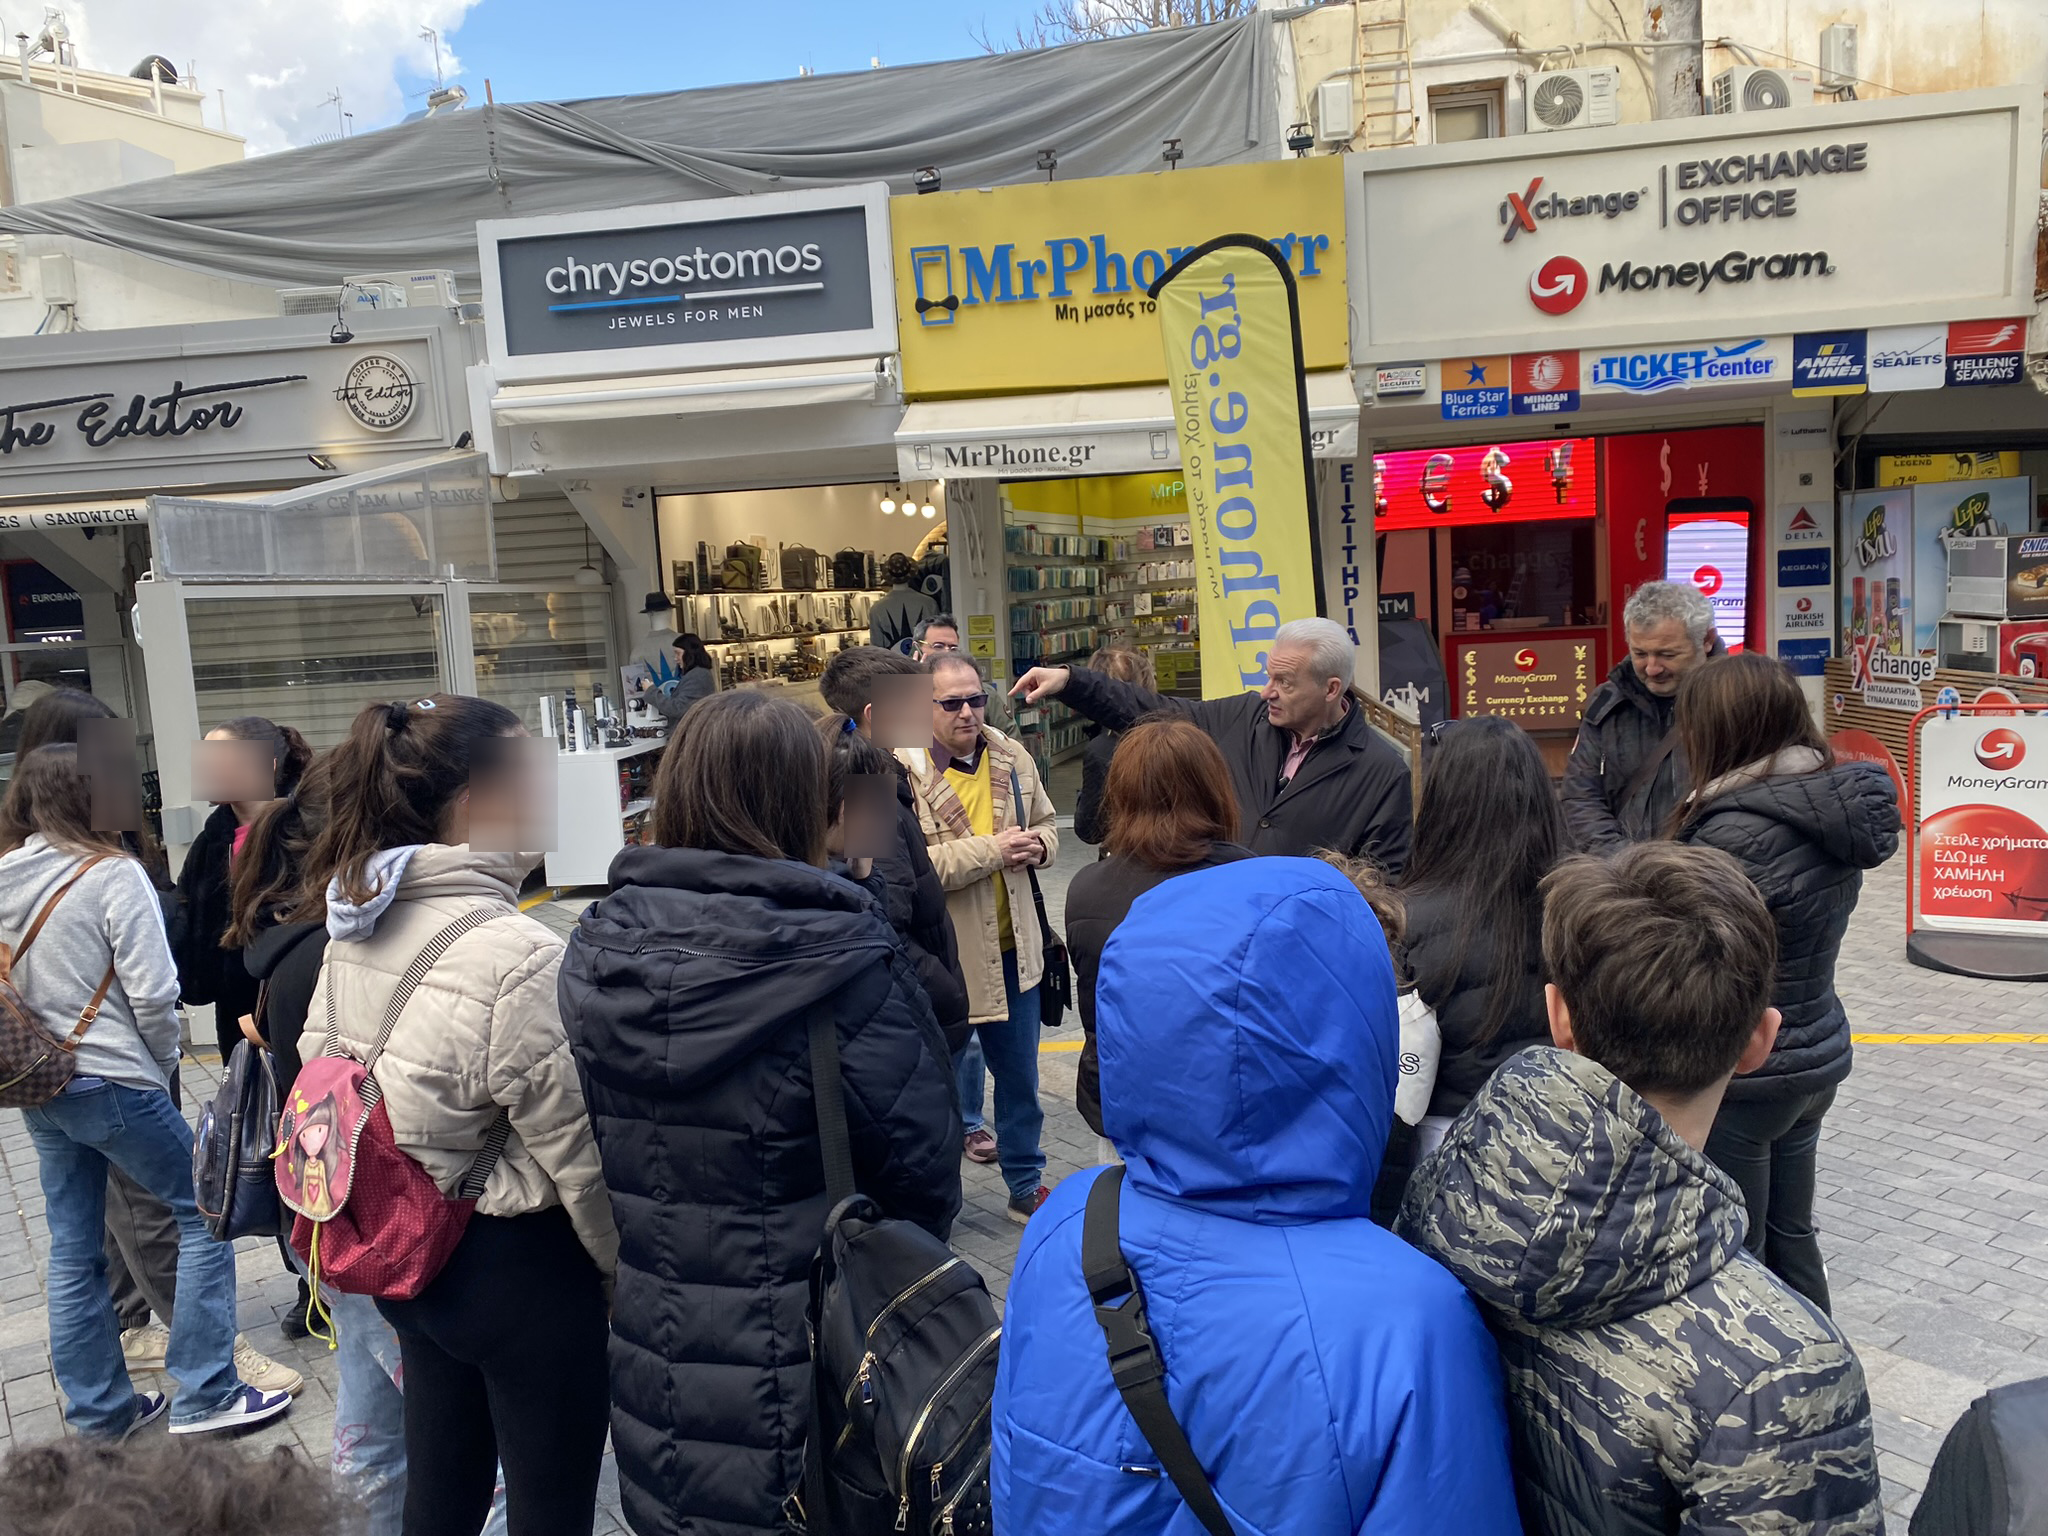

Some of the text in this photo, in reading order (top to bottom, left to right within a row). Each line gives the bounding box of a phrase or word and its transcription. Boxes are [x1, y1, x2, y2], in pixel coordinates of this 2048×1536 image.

[1679, 143, 1867, 189] EXCHANGE
[1499, 177, 1640, 242] iXchange
[1677, 188, 1797, 225] OFFICE
[545, 243, 823, 295] chrysostomos
[1599, 251, 1828, 294] MoneyGram
[608, 306, 764, 329] JEWELS FOR MEN
[1055, 299, 1156, 323] Μη μασάς το
[352, 359, 380, 378] COFFEE
[1707, 359, 1773, 378] center
[1797, 355, 1856, 369] ANEK
[1872, 354, 1942, 368] SEAJETS
[1953, 356, 2019, 370] HELLENIC
[1807, 365, 1864, 379] LINES
[1955, 367, 2015, 381] SEAWAYS
[1445, 390, 1505, 405] Blue Star
[1523, 393, 1568, 404] MINOAN
[77, 380, 307, 447] Editor
[1451, 404, 1497, 417] Ferries
[1531, 402, 1561, 412] LINES
[1790, 427, 1827, 435] Lufthansa
[944, 443, 1096, 468] MrPhone.gr
[1893, 459, 1932, 467] LEGEND
[0, 508, 138, 529] ES SANDWICH
[1954, 496, 1988, 527] Life
[1864, 508, 1884, 537] Life
[1785, 531, 1823, 540] DELTA
[1780, 563, 1819, 571] AEGEAN
[1785, 613, 1824, 621] TURKISH
[1785, 620, 1825, 628] AIRLINES
[1494, 673, 1557, 684] MoneyGram
[1486, 695, 1569, 707] Currency Exchange
[1934, 832, 1980, 846] Στείλε
[1934, 850, 1988, 866] ΕΔΩ με
[1933, 867, 2005, 882] ΧΑΜΗΛΗ
[1933, 886, 1993, 902] χρέωση
